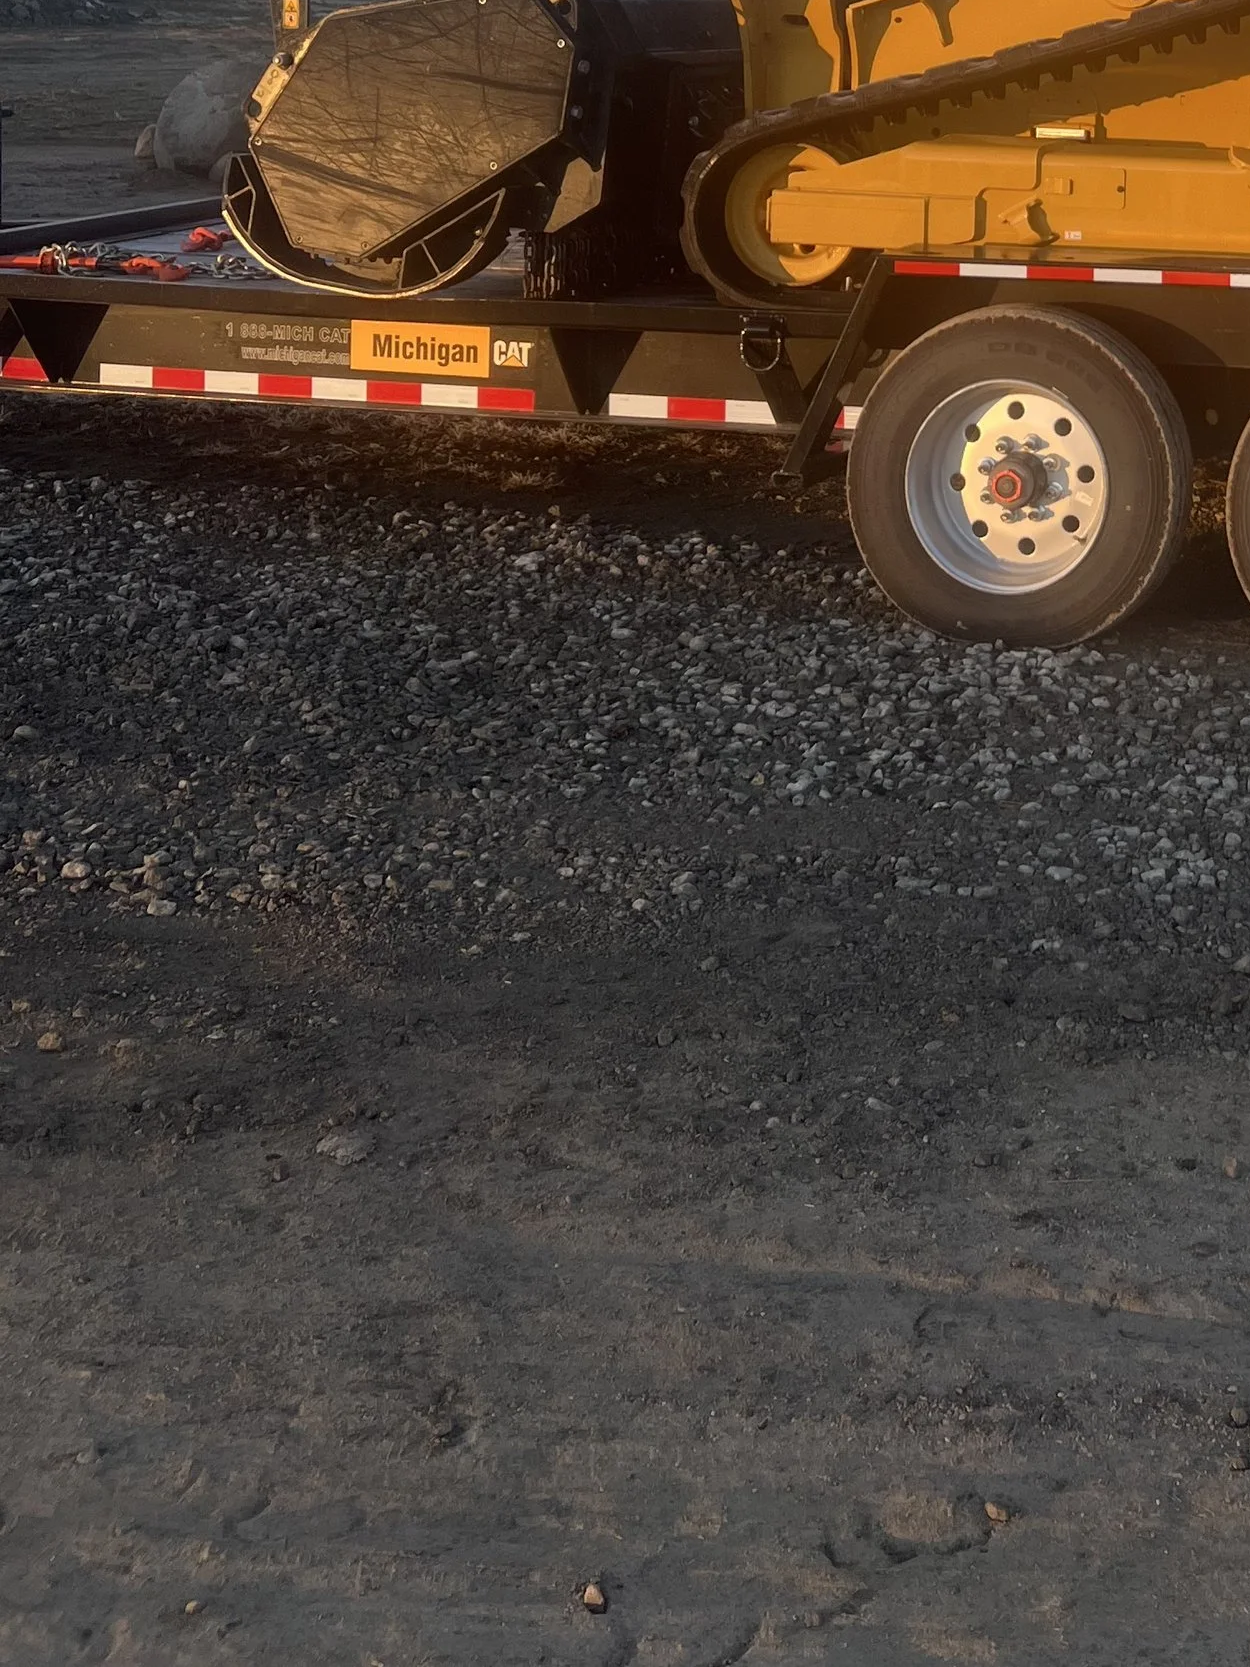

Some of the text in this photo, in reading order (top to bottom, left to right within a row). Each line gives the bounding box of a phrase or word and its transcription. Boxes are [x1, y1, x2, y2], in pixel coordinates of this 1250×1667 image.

[318, 326, 351, 345] CAT
[240, 344, 351, 367] www.michigancat.com
[372, 333, 534, 368] Michigan CAT
